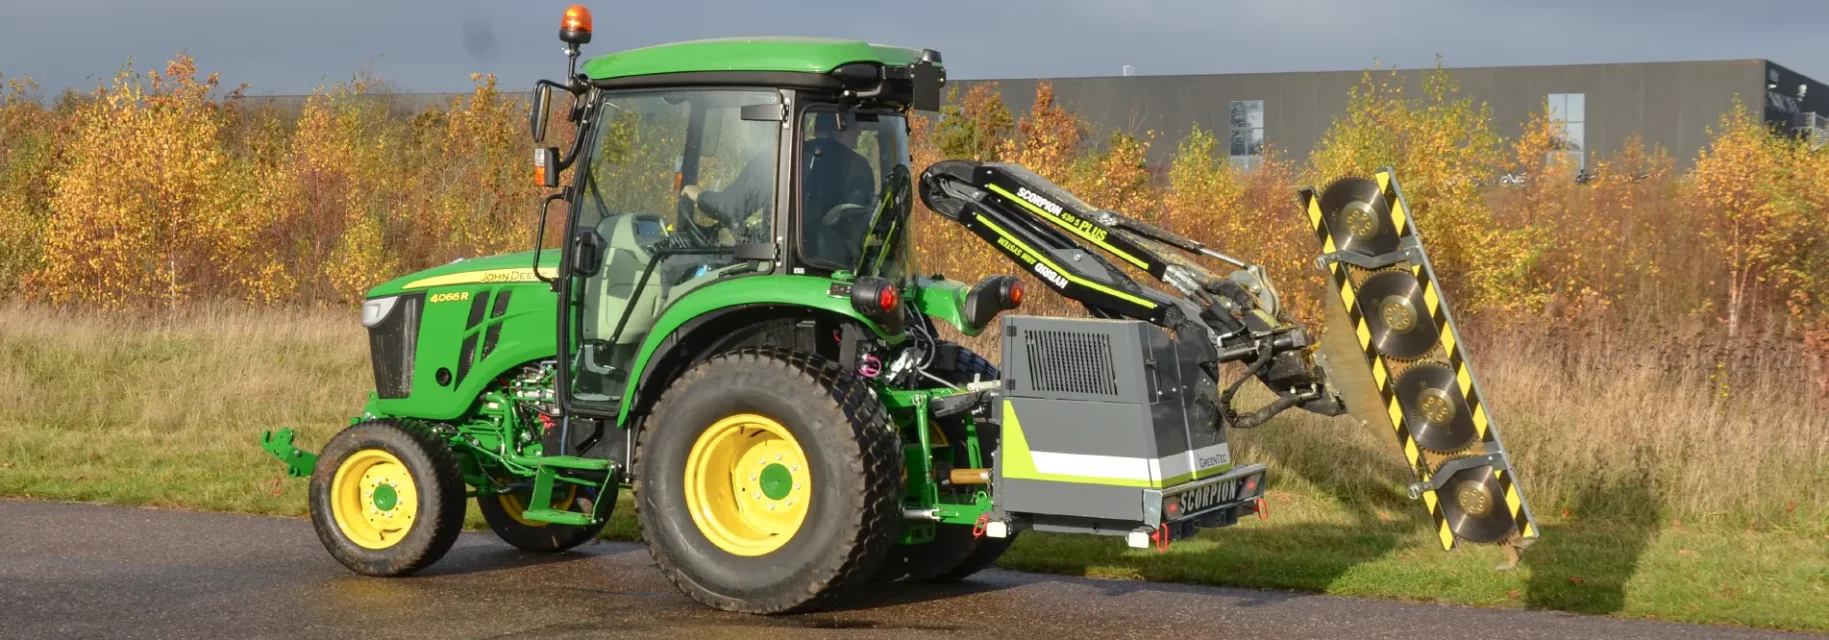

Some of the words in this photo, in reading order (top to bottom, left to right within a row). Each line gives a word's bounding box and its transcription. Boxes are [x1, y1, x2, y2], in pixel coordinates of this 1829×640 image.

[1017, 187, 1063, 216] SCORPION
[1061, 212, 1074, 223] 430
[1079, 221, 1107, 241] PLUS
[997, 236, 1022, 256] SYSTEM
[482, 272, 508, 282] JOHN
[1035, 262, 1069, 289] HYBRID
[430, 292, 460, 303] 4066
[1181, 479, 1236, 513] SCORPION
